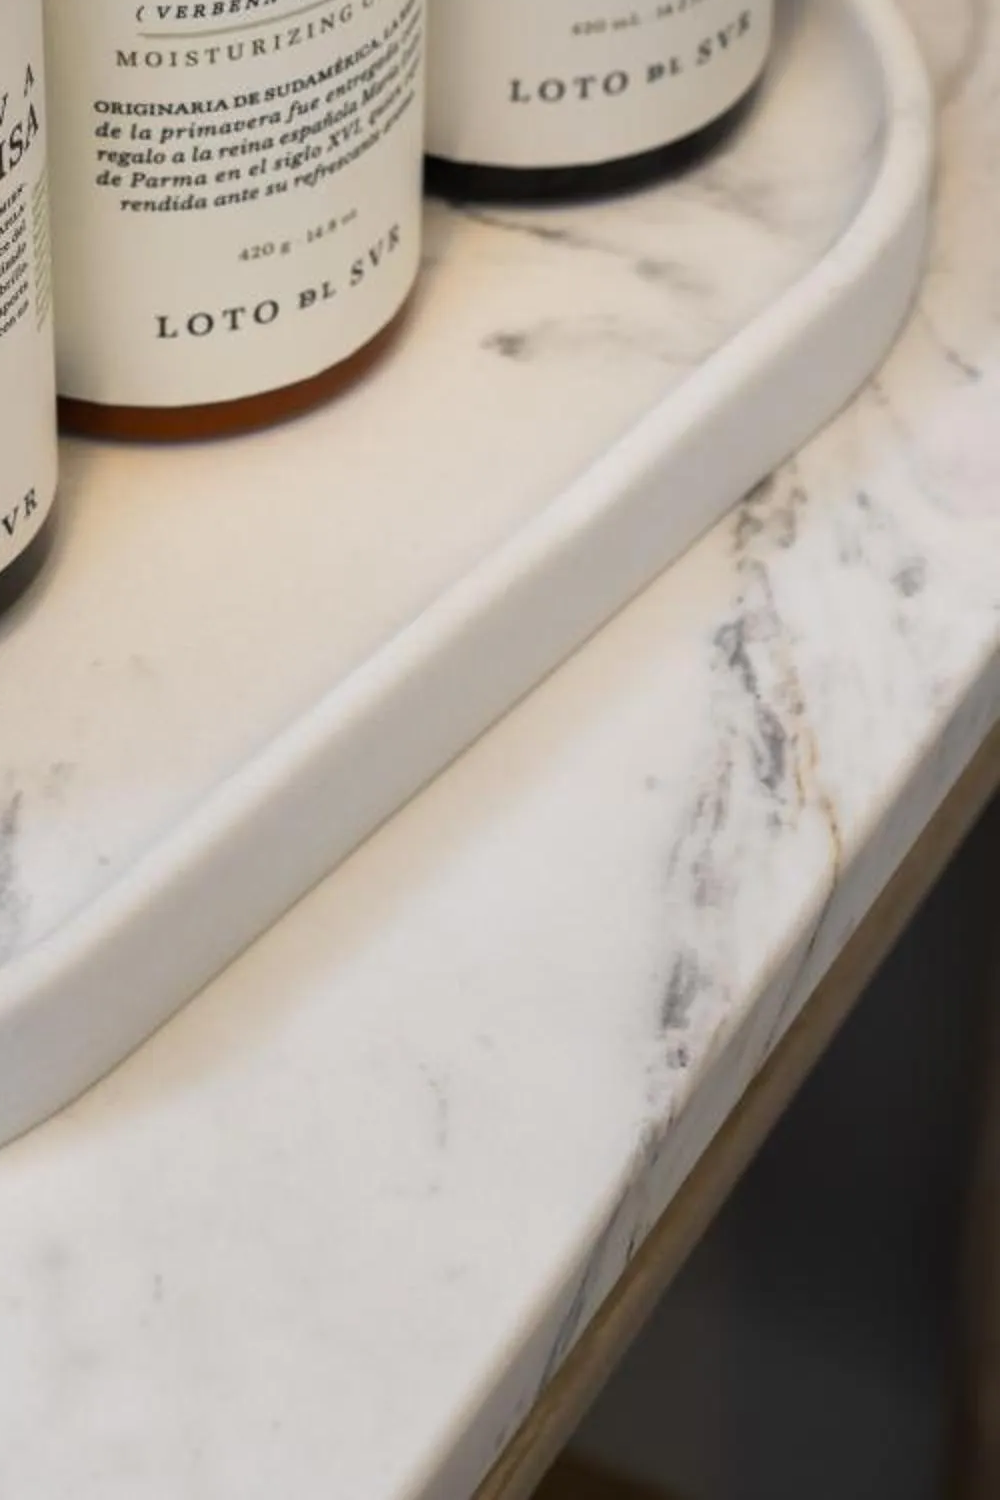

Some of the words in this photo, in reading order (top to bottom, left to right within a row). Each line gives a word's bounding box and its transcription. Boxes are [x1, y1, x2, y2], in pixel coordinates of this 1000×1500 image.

[115, 4, 353, 69] MOISTURIZING
[507, 70, 630, 102] LOTO
[695, 9, 751, 66] SVR
[93, 99, 229, 117] ORIGINARIA
[233, 92, 261, 109] DE
[94, 121, 121, 139] de
[130, 122, 151, 141] la
[160, 111, 281, 144] primavera
[284, 98, 319, 124] fue
[96, 148, 165, 167] regalo
[171, 152, 185, 165] a
[191, 146, 212, 163] la
[218, 137, 274, 160] reina
[279, 101, 358, 143] española
[96, 170, 121, 187] de
[130, 170, 207, 189] Parma
[215, 168, 241, 184] en
[248, 157, 267, 177] el
[272, 144, 322, 171] siglo
[120, 197, 207, 213] rendida
[213, 190, 259, 207] ante
[265, 179, 287, 196] su
[238, 241, 275, 261] 420
[155, 299, 280, 339] LOTO
[349, 223, 400, 287] SVR
